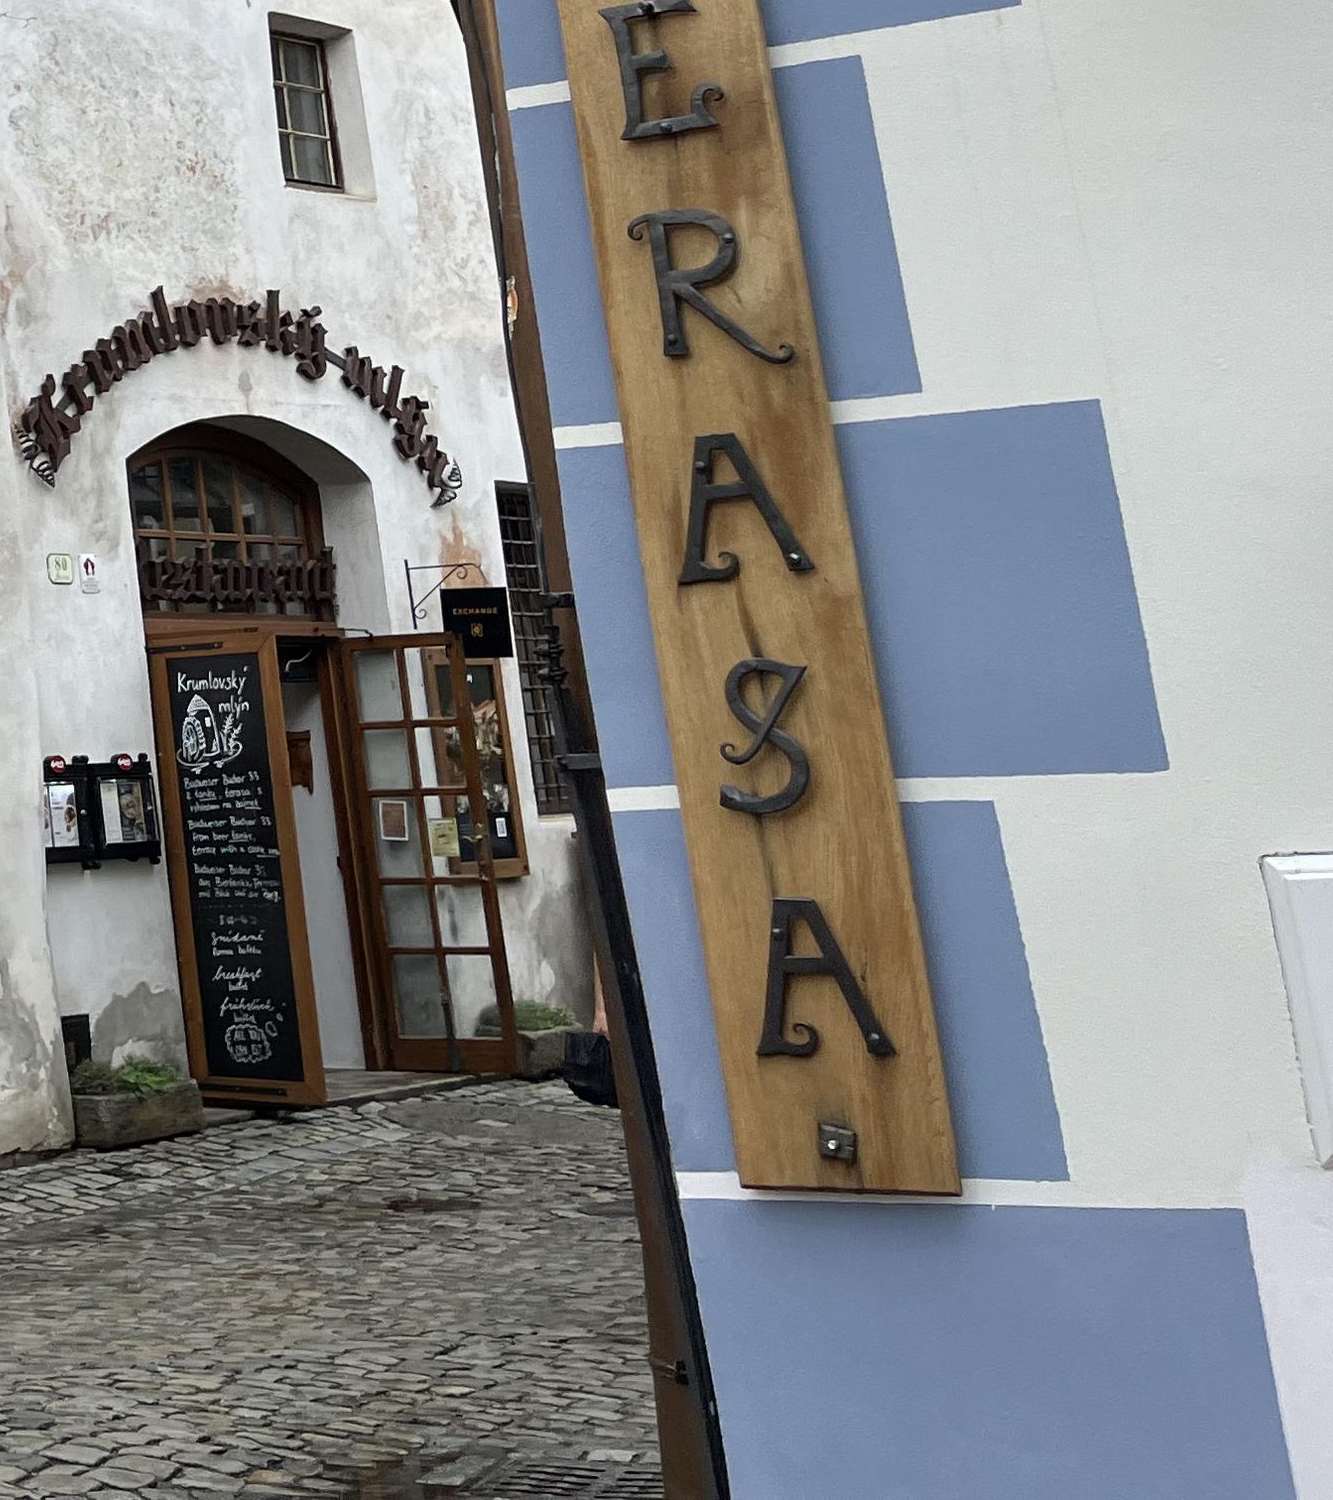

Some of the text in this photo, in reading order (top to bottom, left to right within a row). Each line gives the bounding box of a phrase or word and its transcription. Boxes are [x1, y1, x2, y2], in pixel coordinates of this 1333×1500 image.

[54, 556, 68, 572] 80
[453, 606, 498, 615] EXCHANGE
[177, 666, 248, 695] Krumlovský
[218, 695, 250, 719] mlýn
